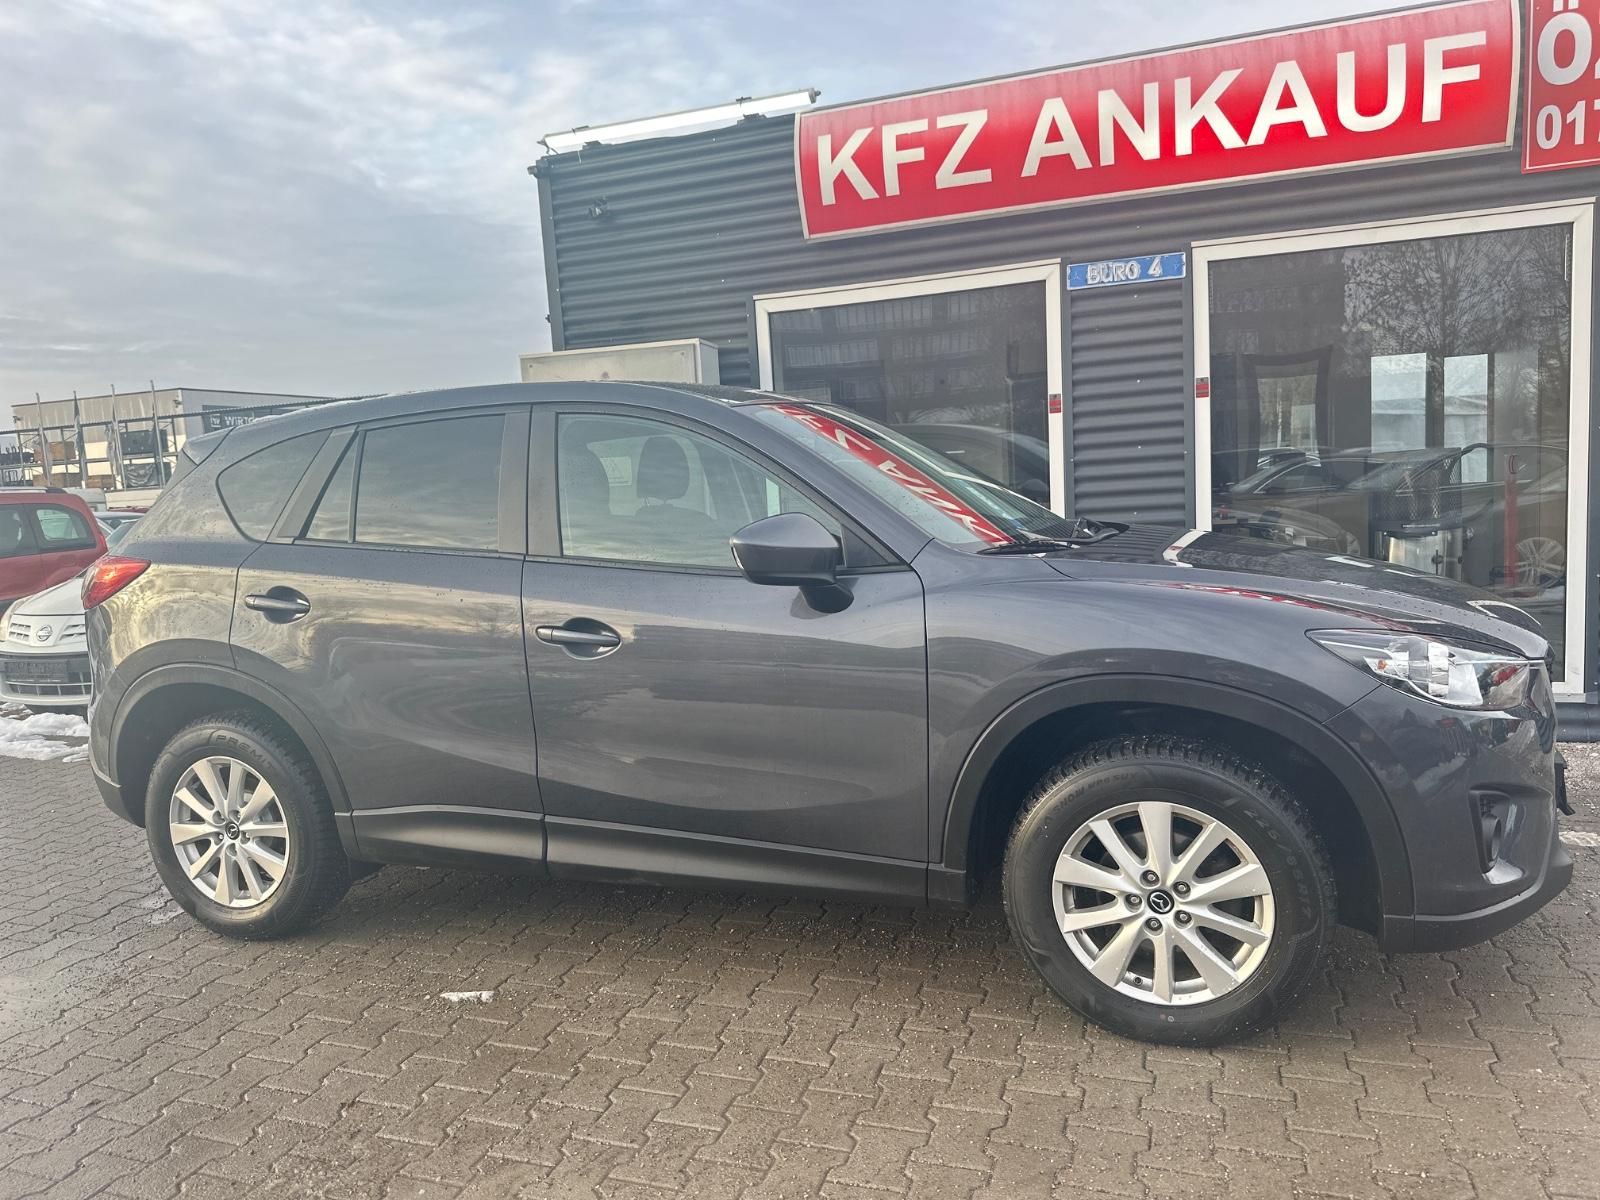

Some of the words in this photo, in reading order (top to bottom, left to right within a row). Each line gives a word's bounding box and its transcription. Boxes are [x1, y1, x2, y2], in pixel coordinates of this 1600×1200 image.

[1537, 0, 1600, 86] Ö
[817, 109, 992, 206] KFZ
[1020, 30, 1487, 178] ANKAUF
[1536, 99, 1600, 150] 01
[1147, 256, 1163, 278] 4
